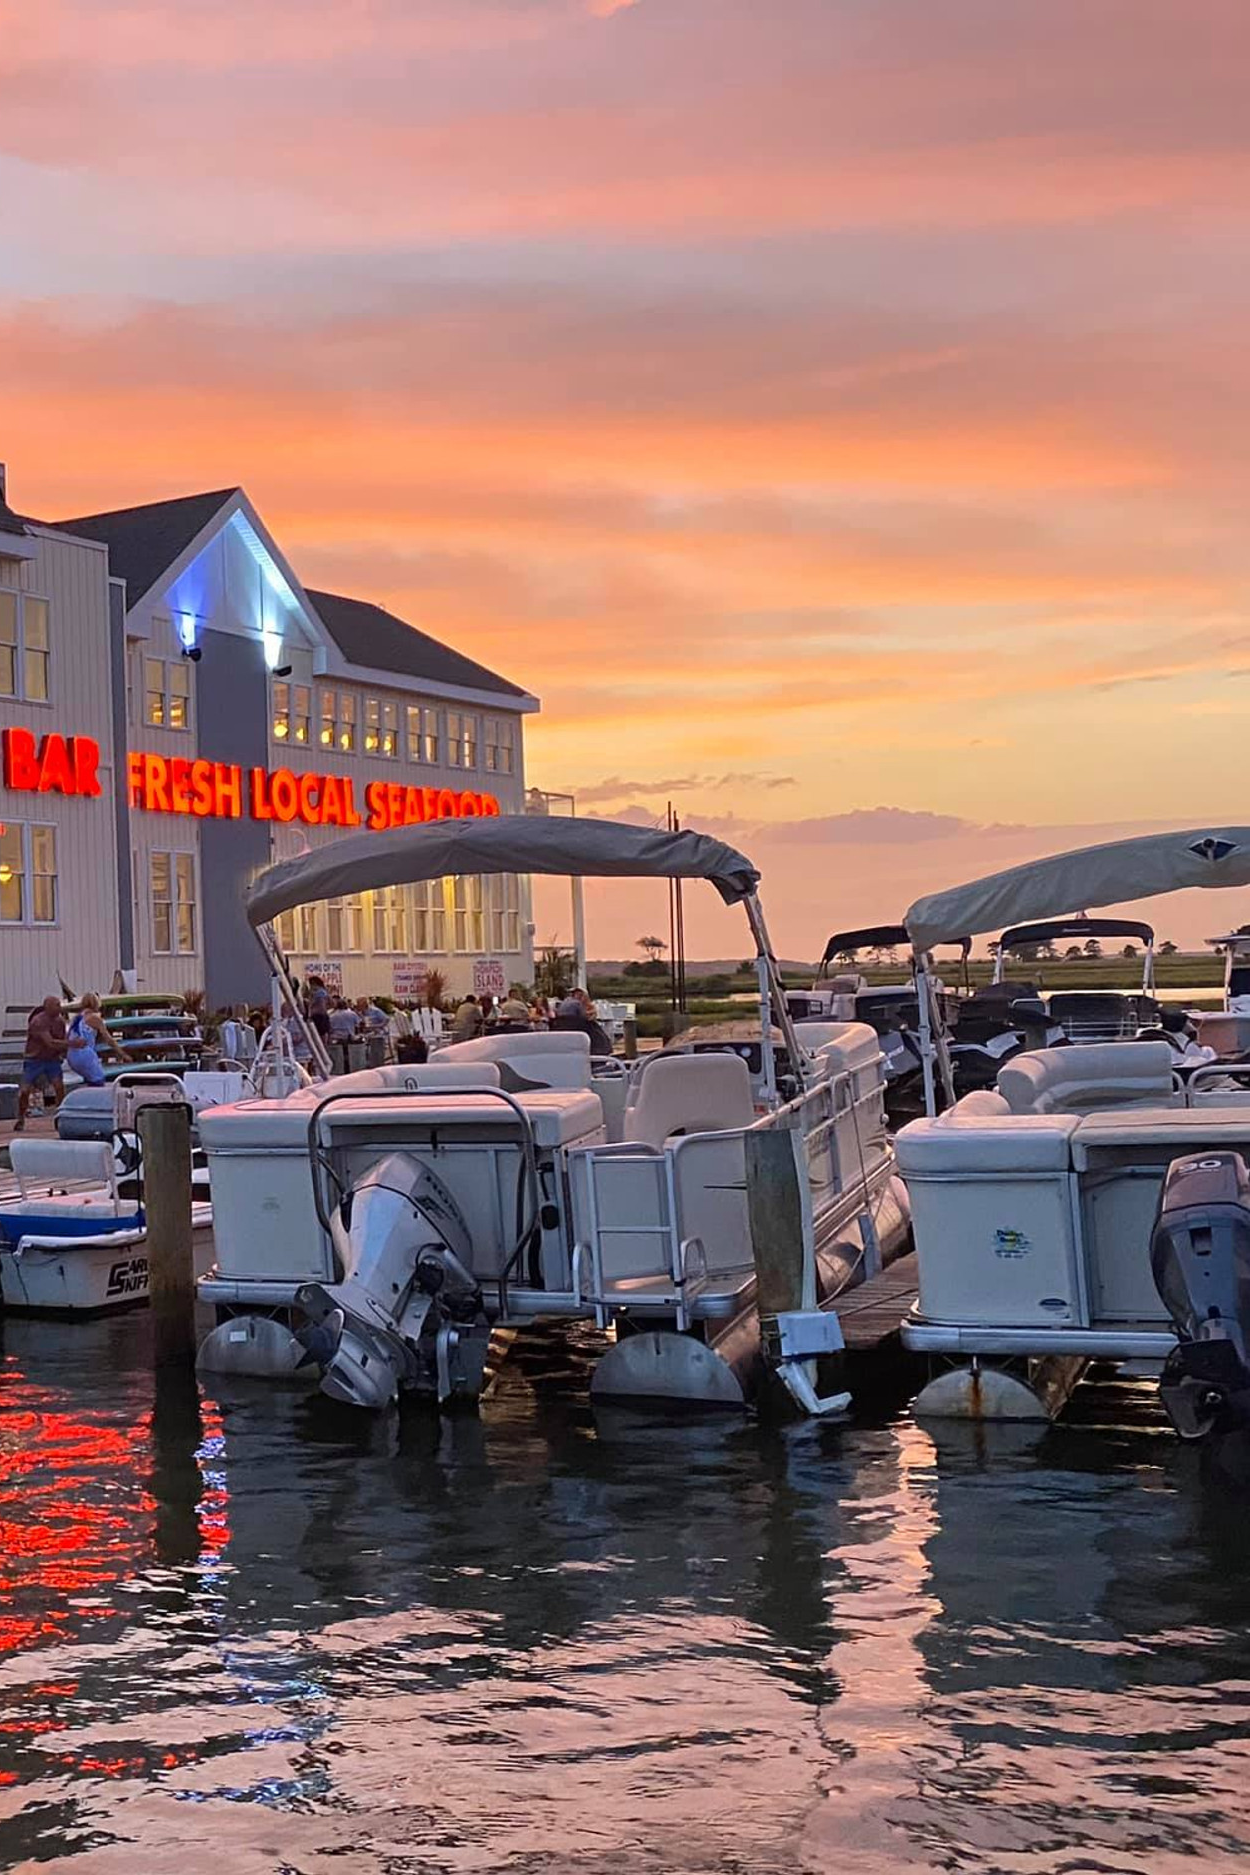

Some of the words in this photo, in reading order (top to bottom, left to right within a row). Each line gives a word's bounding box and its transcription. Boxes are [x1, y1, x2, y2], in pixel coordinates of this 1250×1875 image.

[1, 726, 102, 797] BAR
[127, 752, 242, 819] FRESH
[250, 766, 362, 827] LOCAL
[365, 780, 500, 831] SEAFOOD
[474, 974, 504, 988] ISLAND
